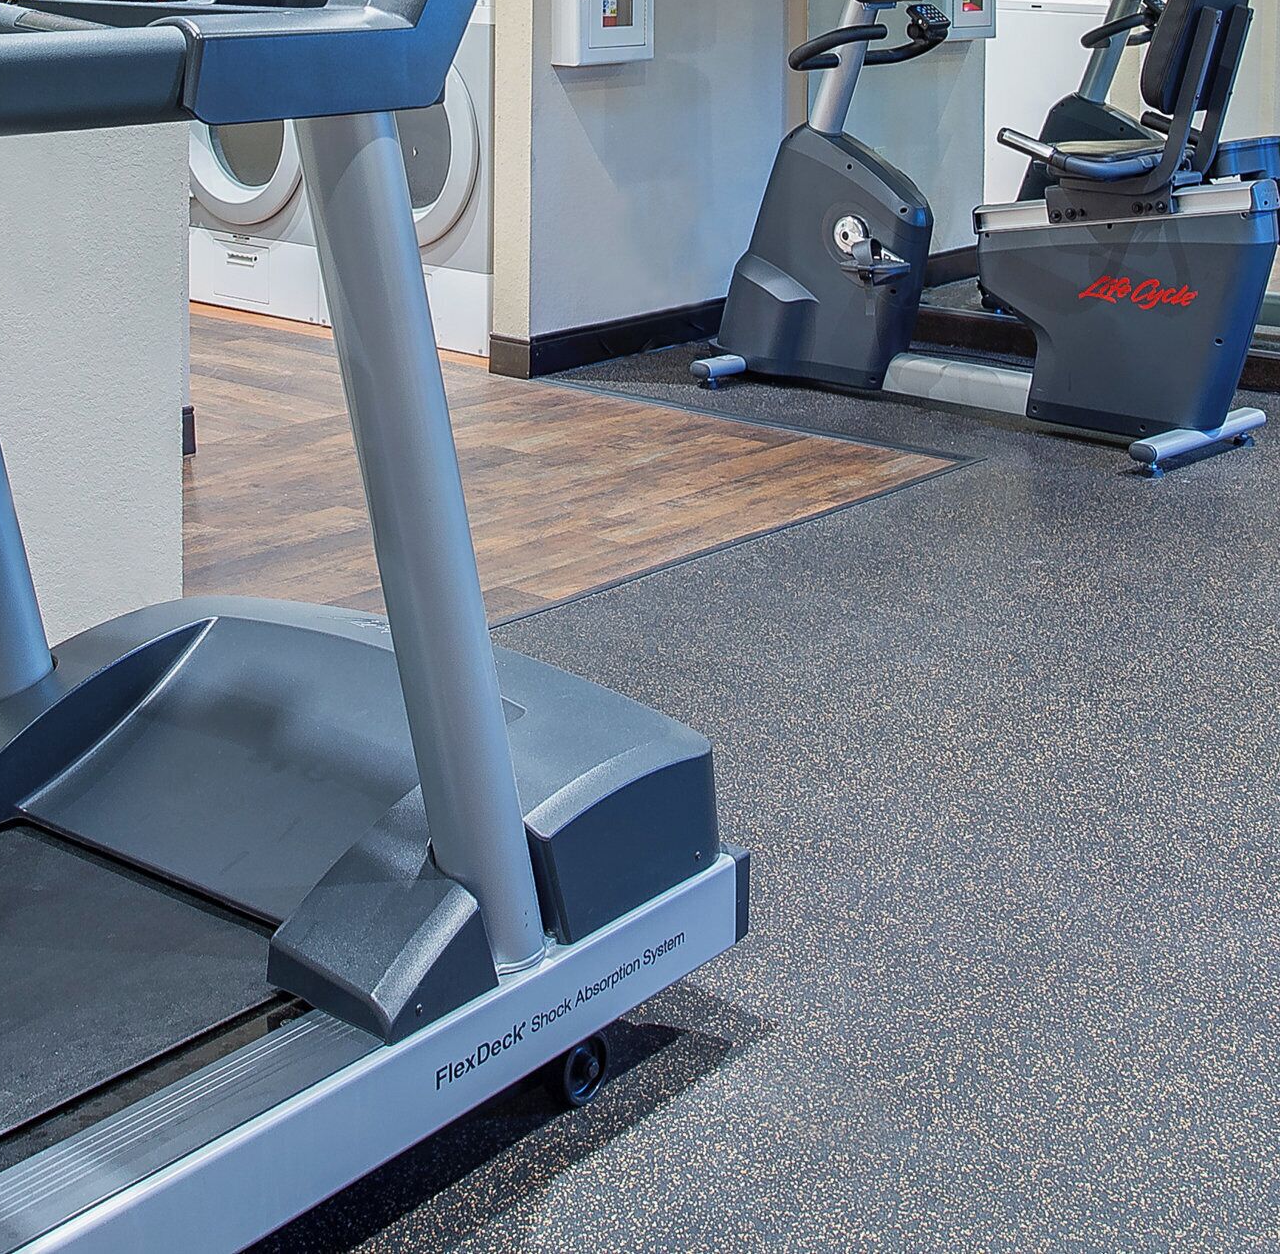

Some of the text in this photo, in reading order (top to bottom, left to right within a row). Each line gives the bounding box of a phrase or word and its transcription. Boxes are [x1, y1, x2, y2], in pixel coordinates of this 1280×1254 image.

[1078, 275, 1198, 310] Life Cycle
[531, 997, 573, 1033] Shock
[574, 957, 641, 1009] Absorption
[642, 931, 686, 966] System
